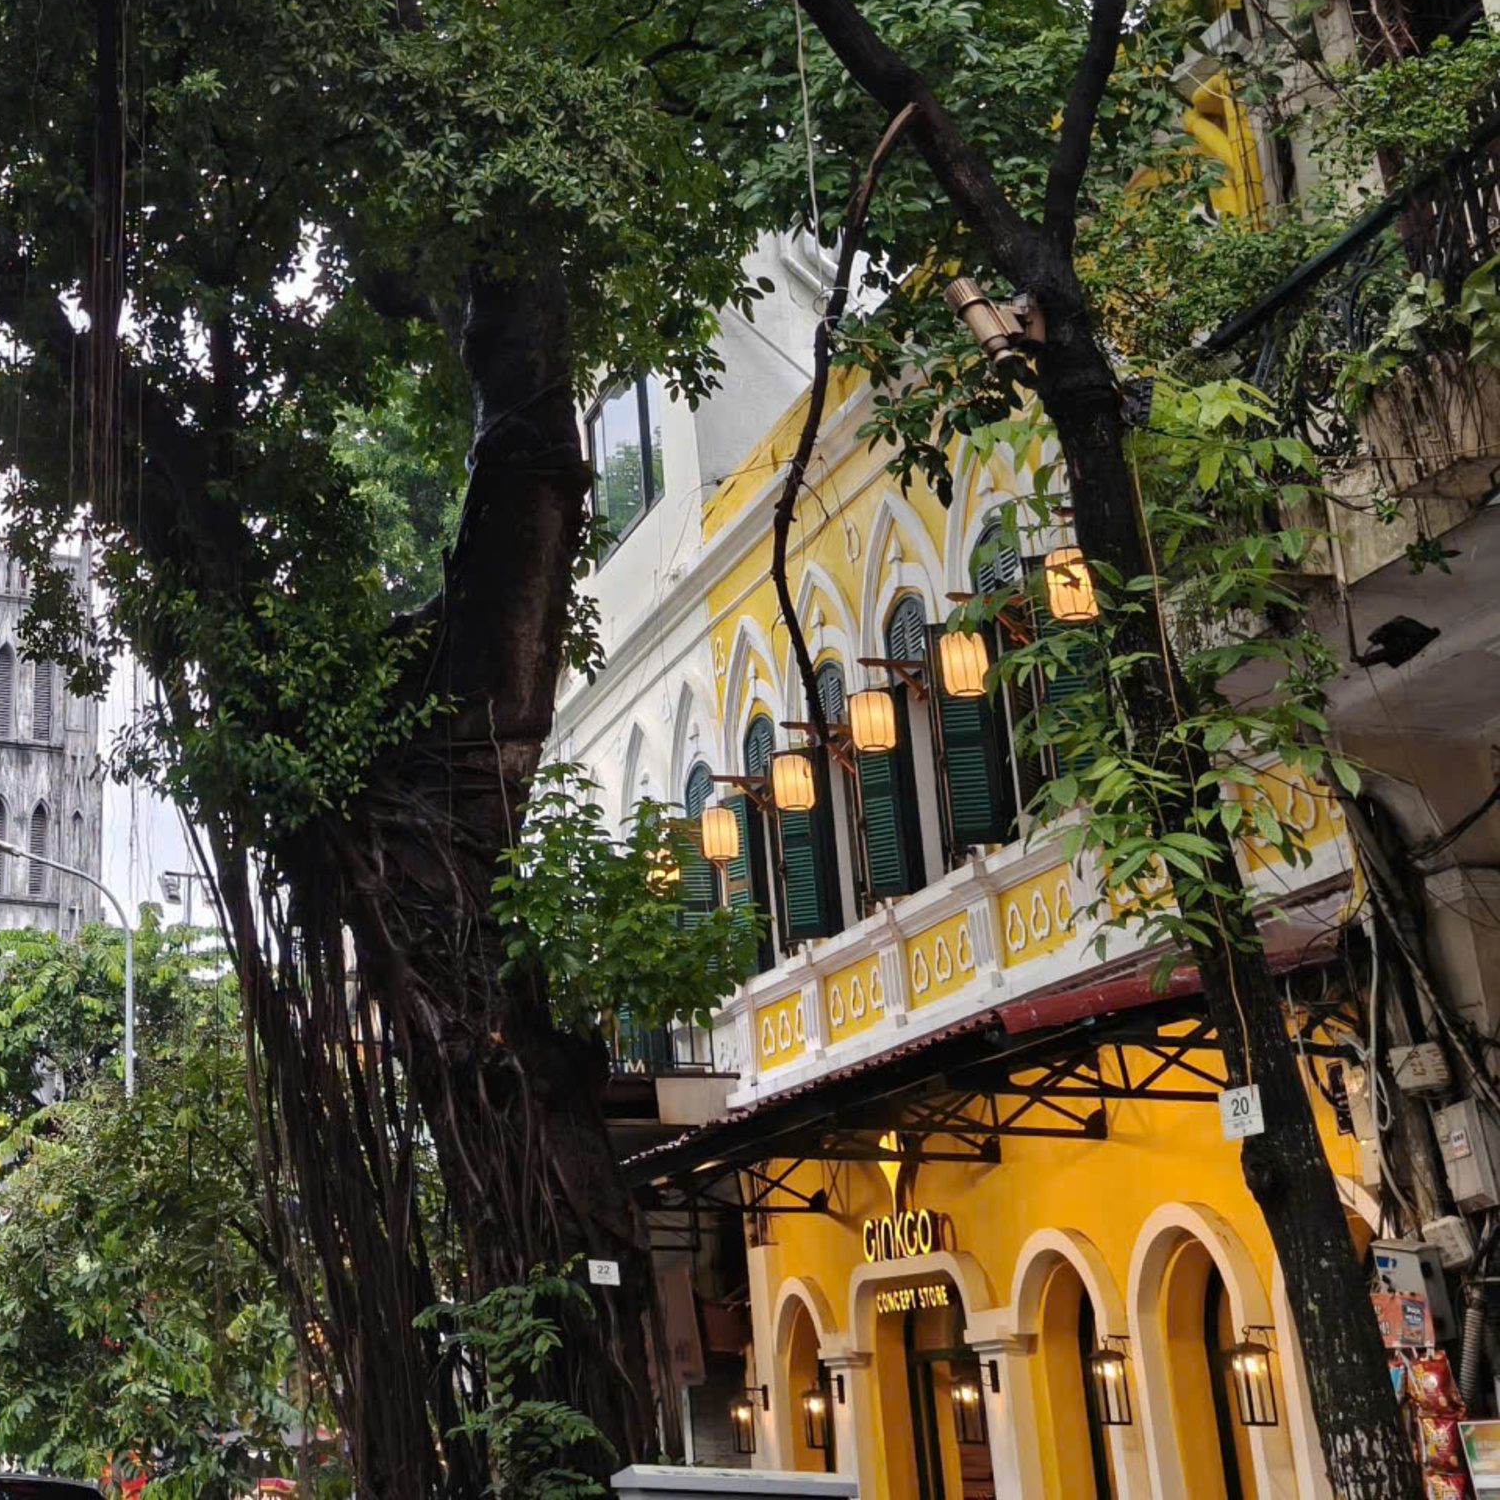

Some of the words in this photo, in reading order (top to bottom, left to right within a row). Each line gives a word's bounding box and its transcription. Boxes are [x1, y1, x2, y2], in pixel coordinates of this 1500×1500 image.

[1231, 1097, 1249, 1117] 20
[597, 1265, 610, 1274] 22
[876, 1288, 916, 1313] CONCEPT
[918, 1285, 950, 1308] STORE
